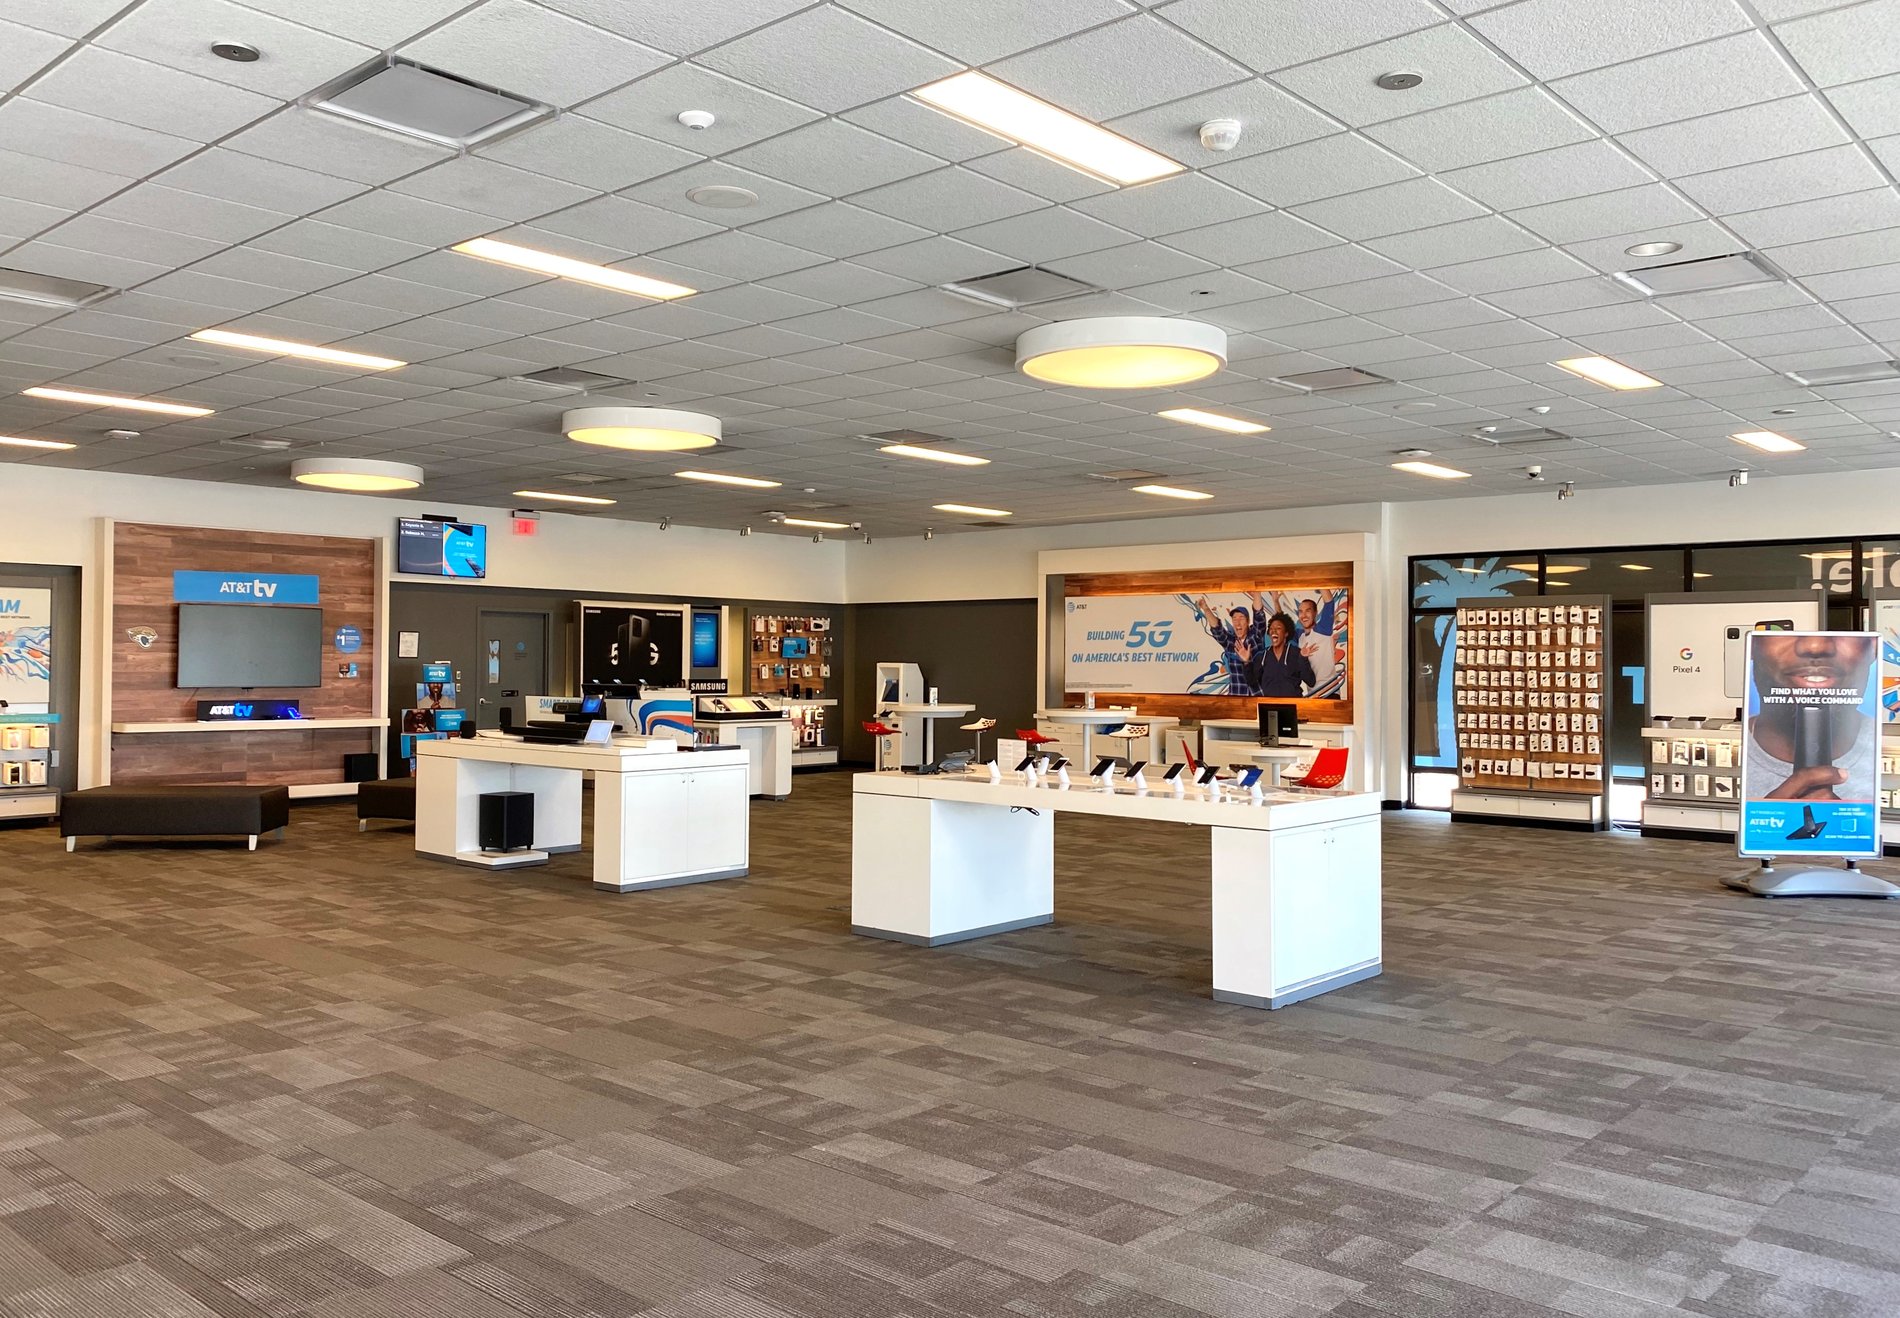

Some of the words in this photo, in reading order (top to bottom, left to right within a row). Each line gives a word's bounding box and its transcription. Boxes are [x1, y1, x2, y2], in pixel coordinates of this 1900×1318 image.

[220, 582, 252, 593] AT&T
[253, 579, 277, 598] tv
[1087, 631, 1125, 641] BUILDING
[1125, 621, 1173, 648] 5G
[1072, 653, 1083, 663] ON
[1085, 653, 1130, 663] AMERICA'S
[1131, 652, 1153, 662] BEST
[1155, 652, 1200, 662] NETWORK
[1673, 665, 1693, 673] Pixel
[690, 682, 726, 691] SAMSUNG
[1770, 687, 1791, 695] FIND
[209, 705, 234, 715] AT&T
[234, 702, 253, 717] tv
[539, 699, 560, 709] SMA
[1750, 818, 1769, 826] AT&T
[1770, 816, 1785, 828] tv
